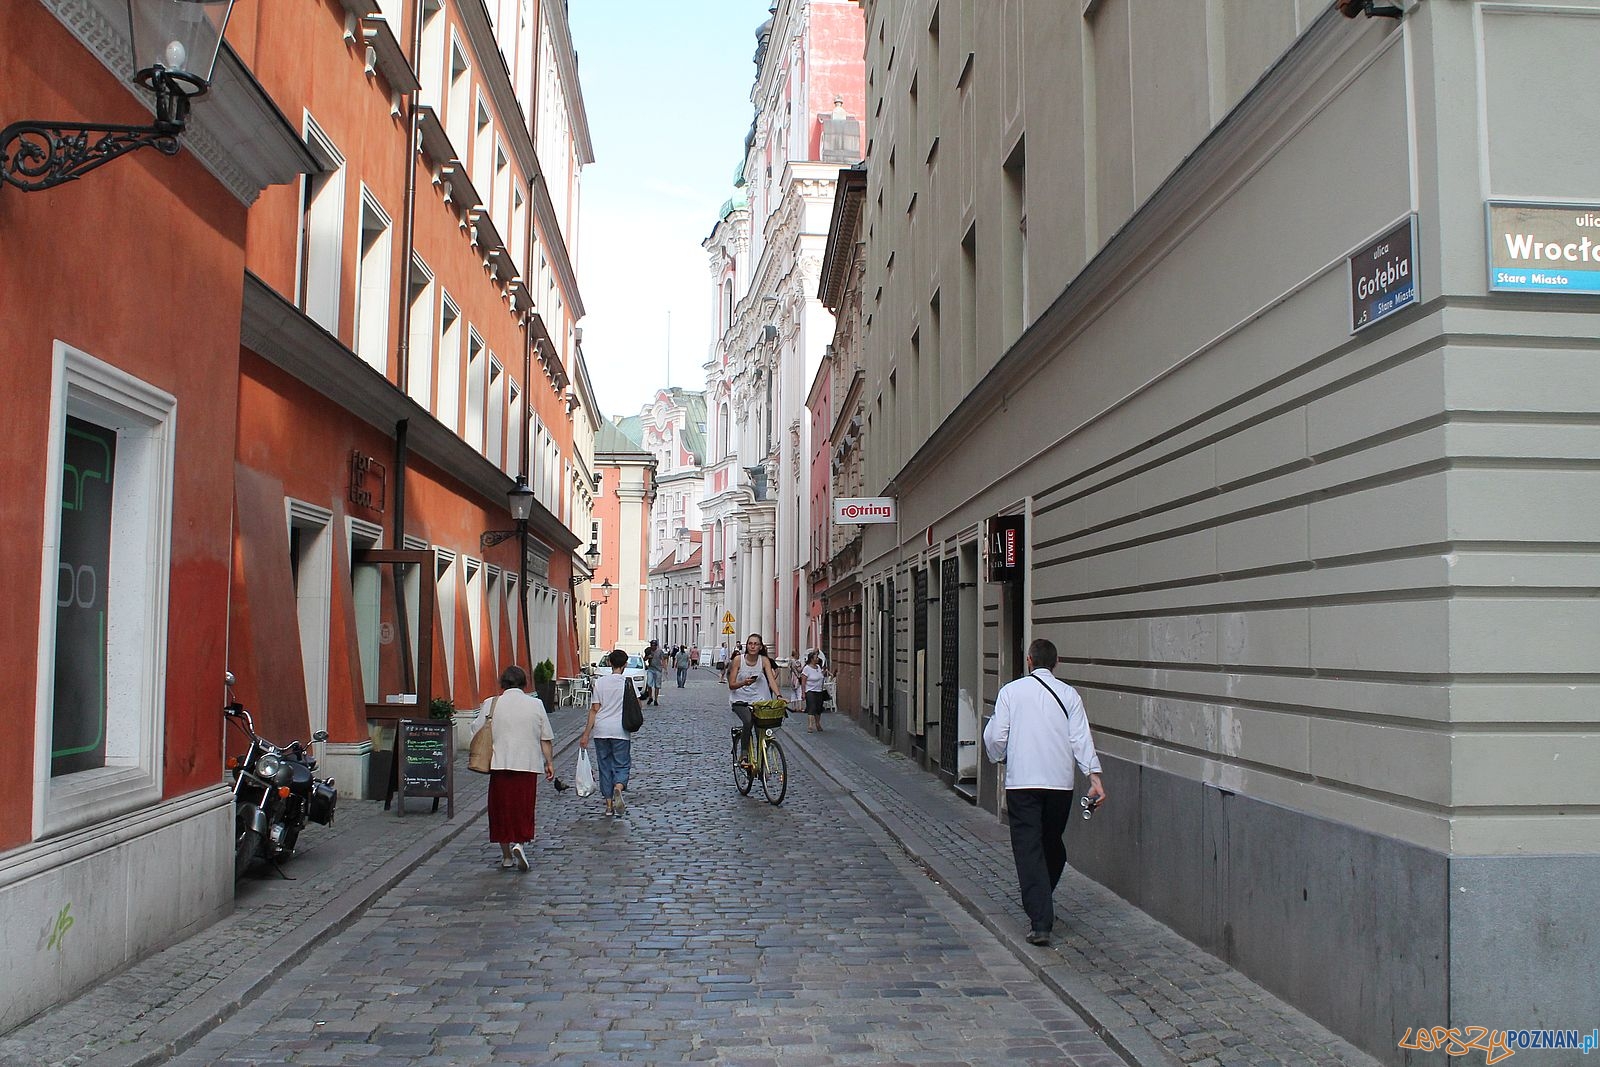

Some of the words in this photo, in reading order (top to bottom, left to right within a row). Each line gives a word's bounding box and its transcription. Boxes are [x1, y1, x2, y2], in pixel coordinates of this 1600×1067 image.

[1373, 243, 1389, 260] ulica
[1357, 256, 1409, 300] Gołębia
[1497, 272, 1527, 284] Stare
[1531, 273, 1568, 285] Miasto
[1378, 300, 1393, 314] Stare
[1394, 287, 1414, 305] Miasto
